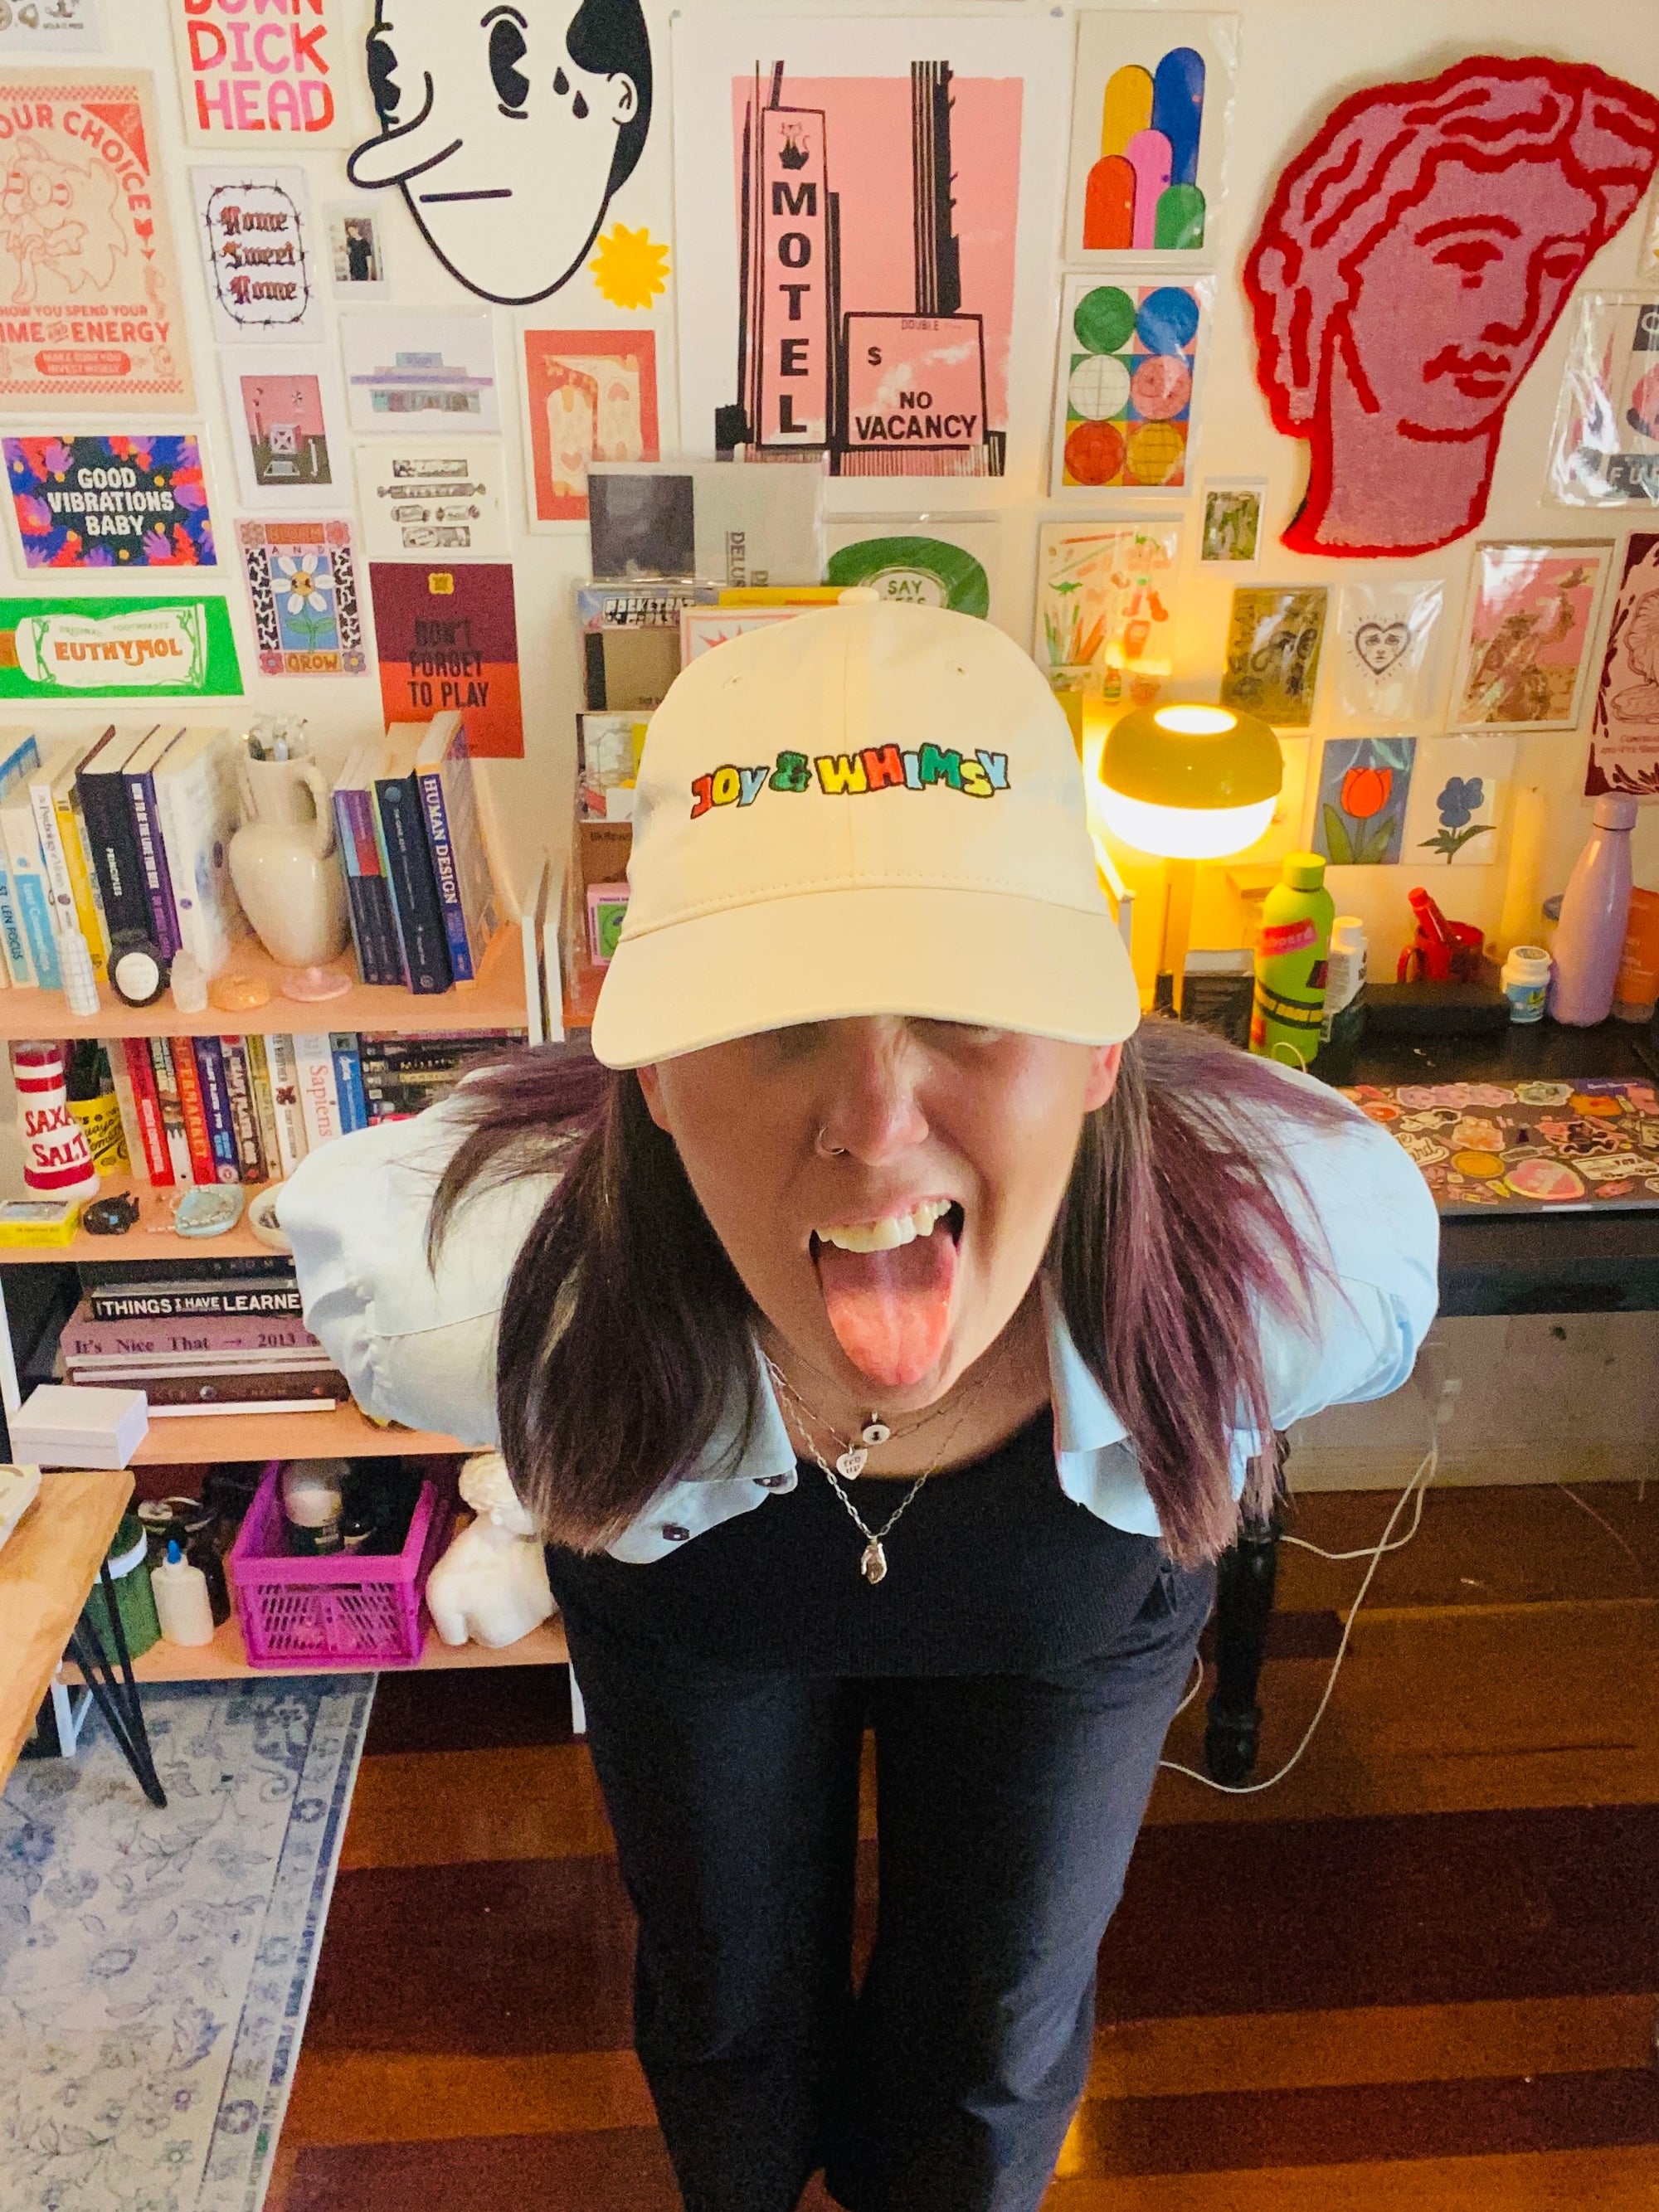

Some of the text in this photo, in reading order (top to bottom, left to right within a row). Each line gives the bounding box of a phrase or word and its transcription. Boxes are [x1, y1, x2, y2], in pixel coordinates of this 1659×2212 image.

[187, 20, 329, 75] DICK
[195, 80, 334, 132] HEAD
[63, 111, 152, 211] CHOICE
[34, 305, 62, 317] YOU
[66, 305, 108, 316] SPEND
[112, 305, 148, 316] YOUR
[772, 182, 817, 433] MOTEL
[71, 321, 170, 343] ENERGY
[899, 391, 932, 410] NO
[855, 415, 977, 440] VACANCY
[77, 468, 136, 489] GOOD
[47, 492, 175, 513] VIBRATIONS
[85, 515, 144, 536] BABY
[888, 580, 922, 596] SAY
[54, 638, 182, 666] EUTHYMOL
[287, 654, 338, 670] GROW
[408, 651, 483, 678] FORGET
[407, 681, 489, 707] TO PLAY
[690, 742, 1011, 819] JOY & WHIMSY
[423, 779, 446, 841] HUMAN
[435, 844, 458, 904] DESIGN
[7, 926, 23, 960] FOCUS
[306, 1065, 333, 1137] Sapiens
[26, 1103, 76, 1137] SAXA
[32, 1132, 88, 1167] SALT
[105, 1299, 173, 1315] THINGS
[185, 1297, 220, 1310] HAVE
[75, 1339, 102, 1354] It's
[116, 1339, 154, 1353] Nice
[168, 1336, 208, 1351] That
[258, 1334, 295, 1348] 2013
